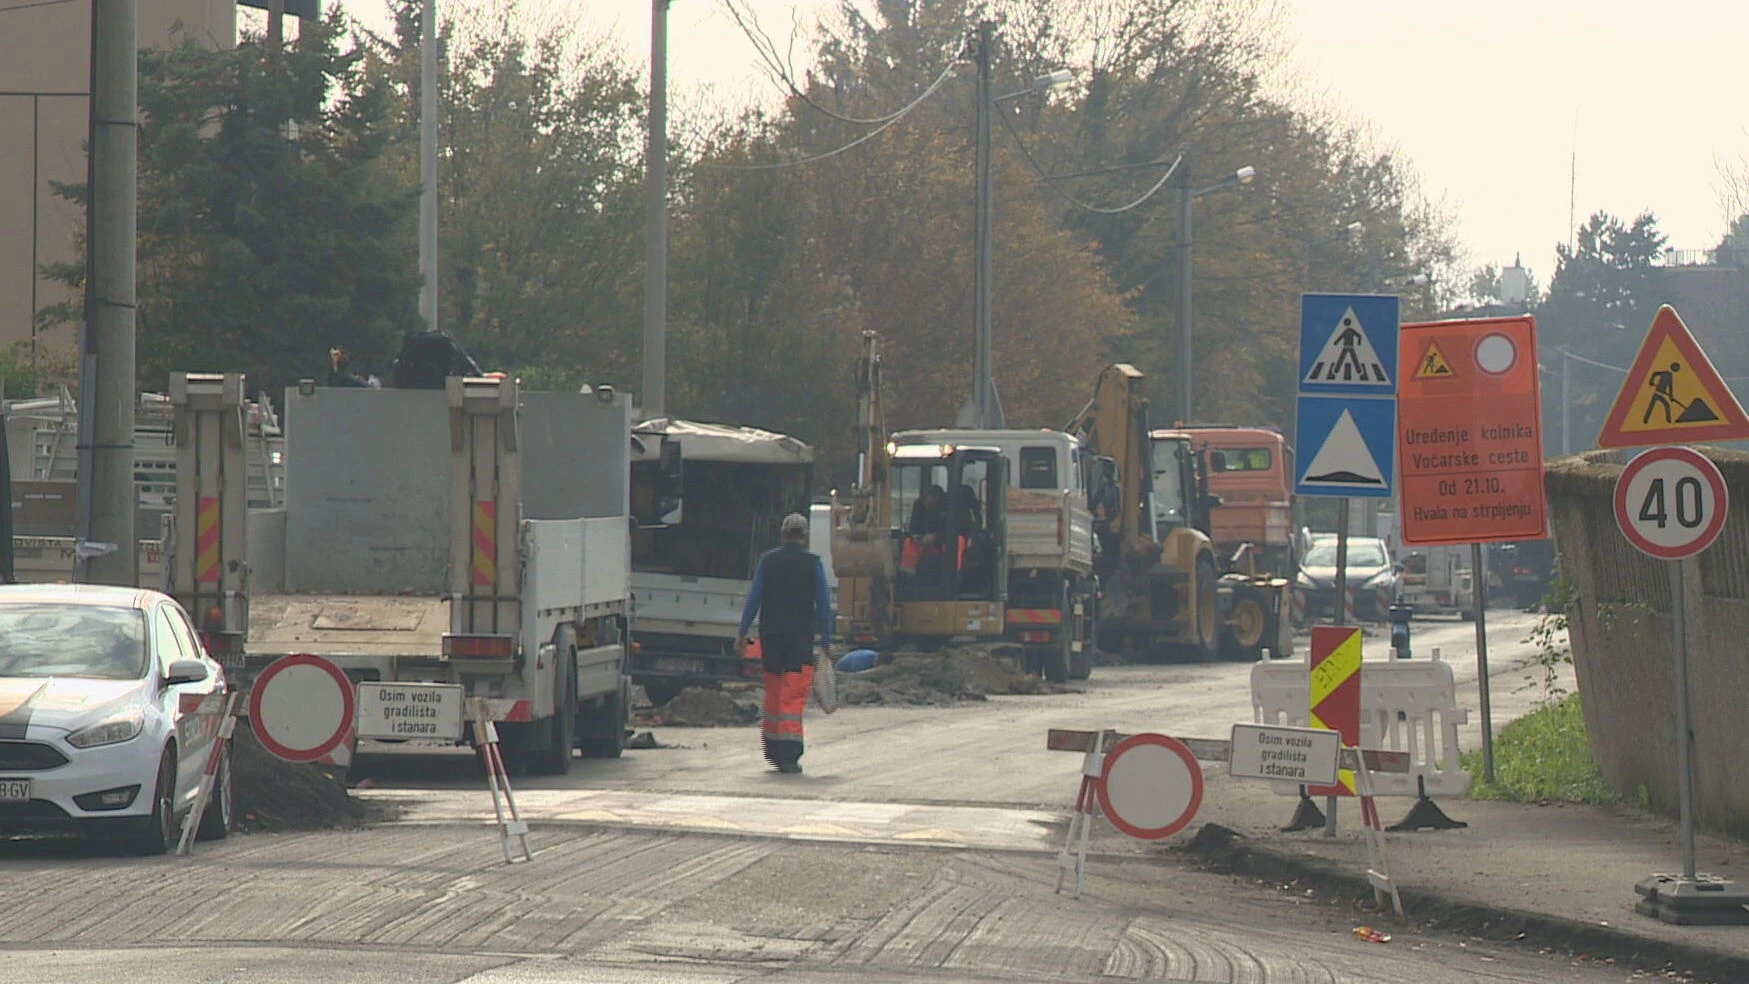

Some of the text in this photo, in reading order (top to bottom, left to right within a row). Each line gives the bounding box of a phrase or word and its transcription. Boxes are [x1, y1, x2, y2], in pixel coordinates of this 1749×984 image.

[1405, 423, 1533, 446] Uređenje kolnika
[1488, 448, 1529, 465] ceste
[1438, 477, 1506, 496] Od 21.10.
[1639, 476, 1703, 529] 40
[1413, 502, 1532, 521] Hvala na strpljenju
[380, 689, 442, 704] Osim vozila
[383, 705, 437, 720] gradilišta
[391, 720, 437, 734] i stanara
[1258, 732, 1312, 748] Osim vozila
[1260, 762, 1305, 778] i stanara
